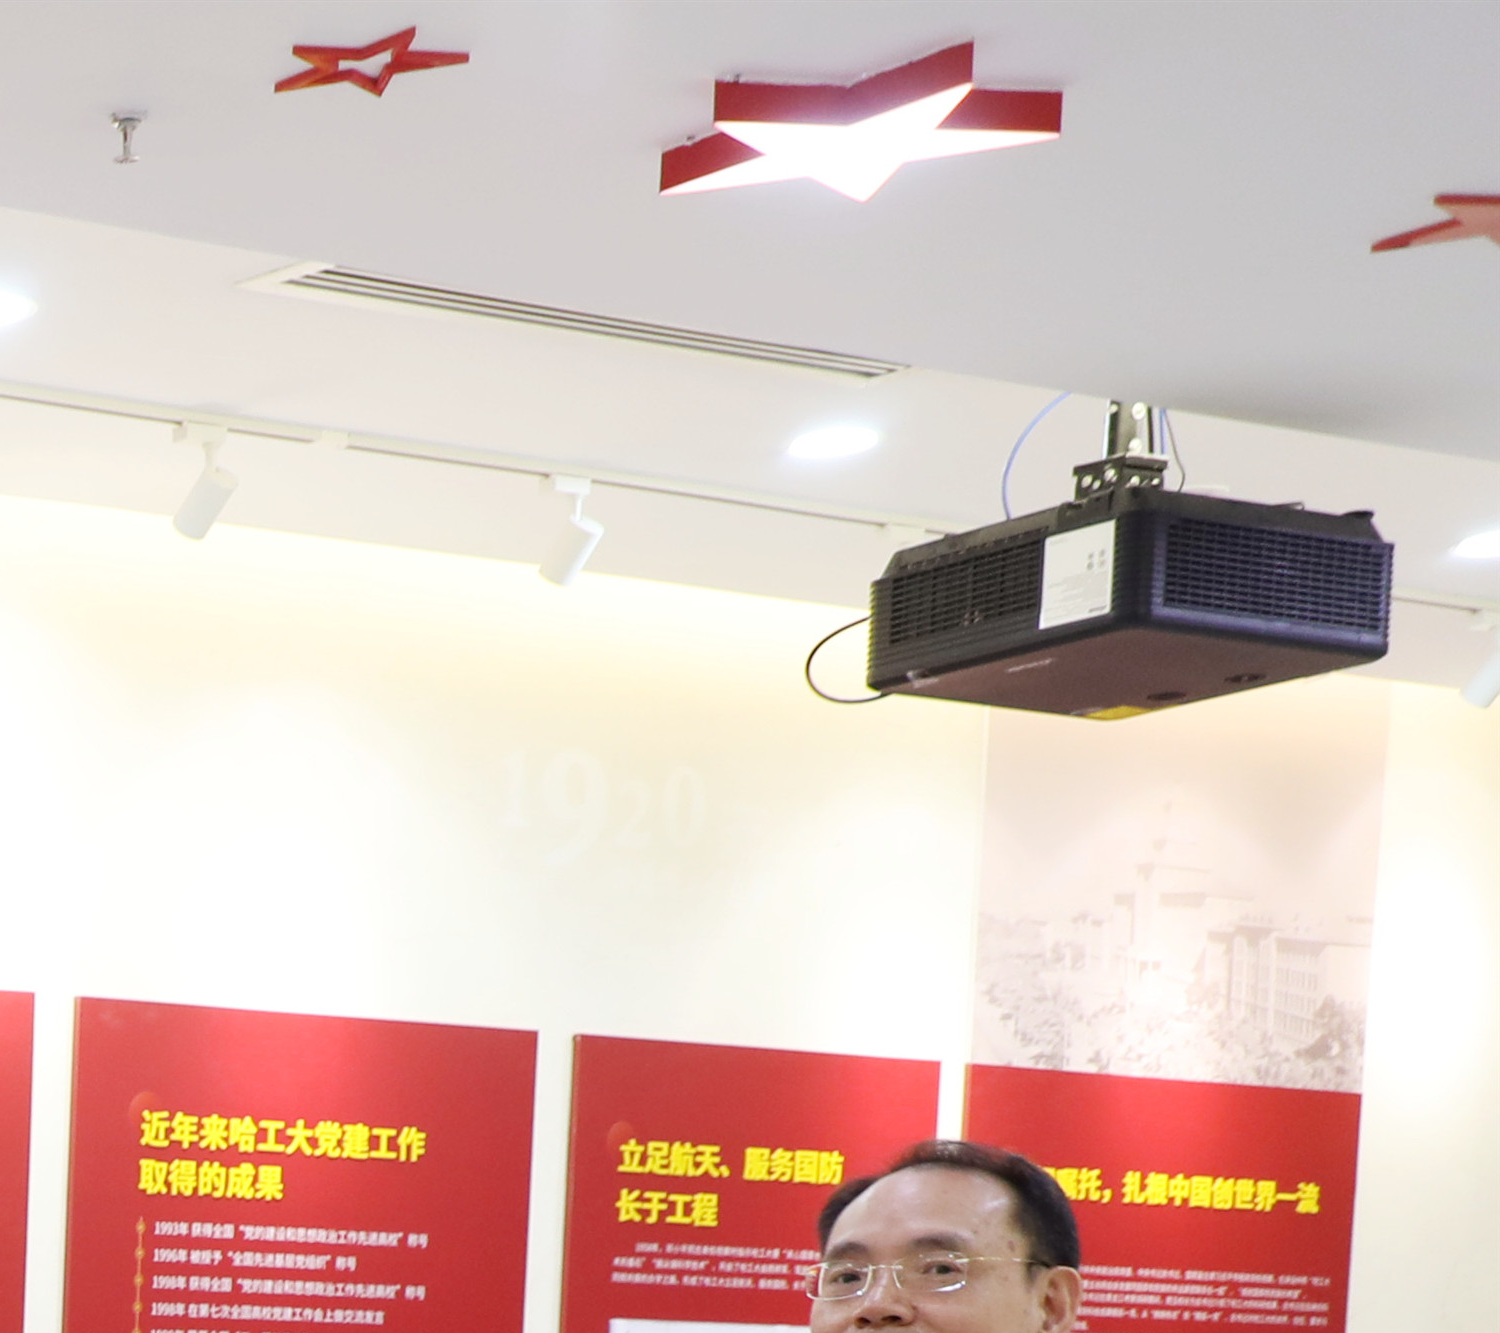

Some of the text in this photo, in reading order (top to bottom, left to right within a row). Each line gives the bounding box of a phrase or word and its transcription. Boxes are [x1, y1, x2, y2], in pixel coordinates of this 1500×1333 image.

[498, 748, 707, 867] 1920
[140, 1109, 426, 1163] 近年来哈工大党建工作
[138, 1157, 284, 1201] 取得的成果
[617, 1138, 845, 1186] 立足航天、服务国防
[615, 1188, 719, 1229] 长于工程
